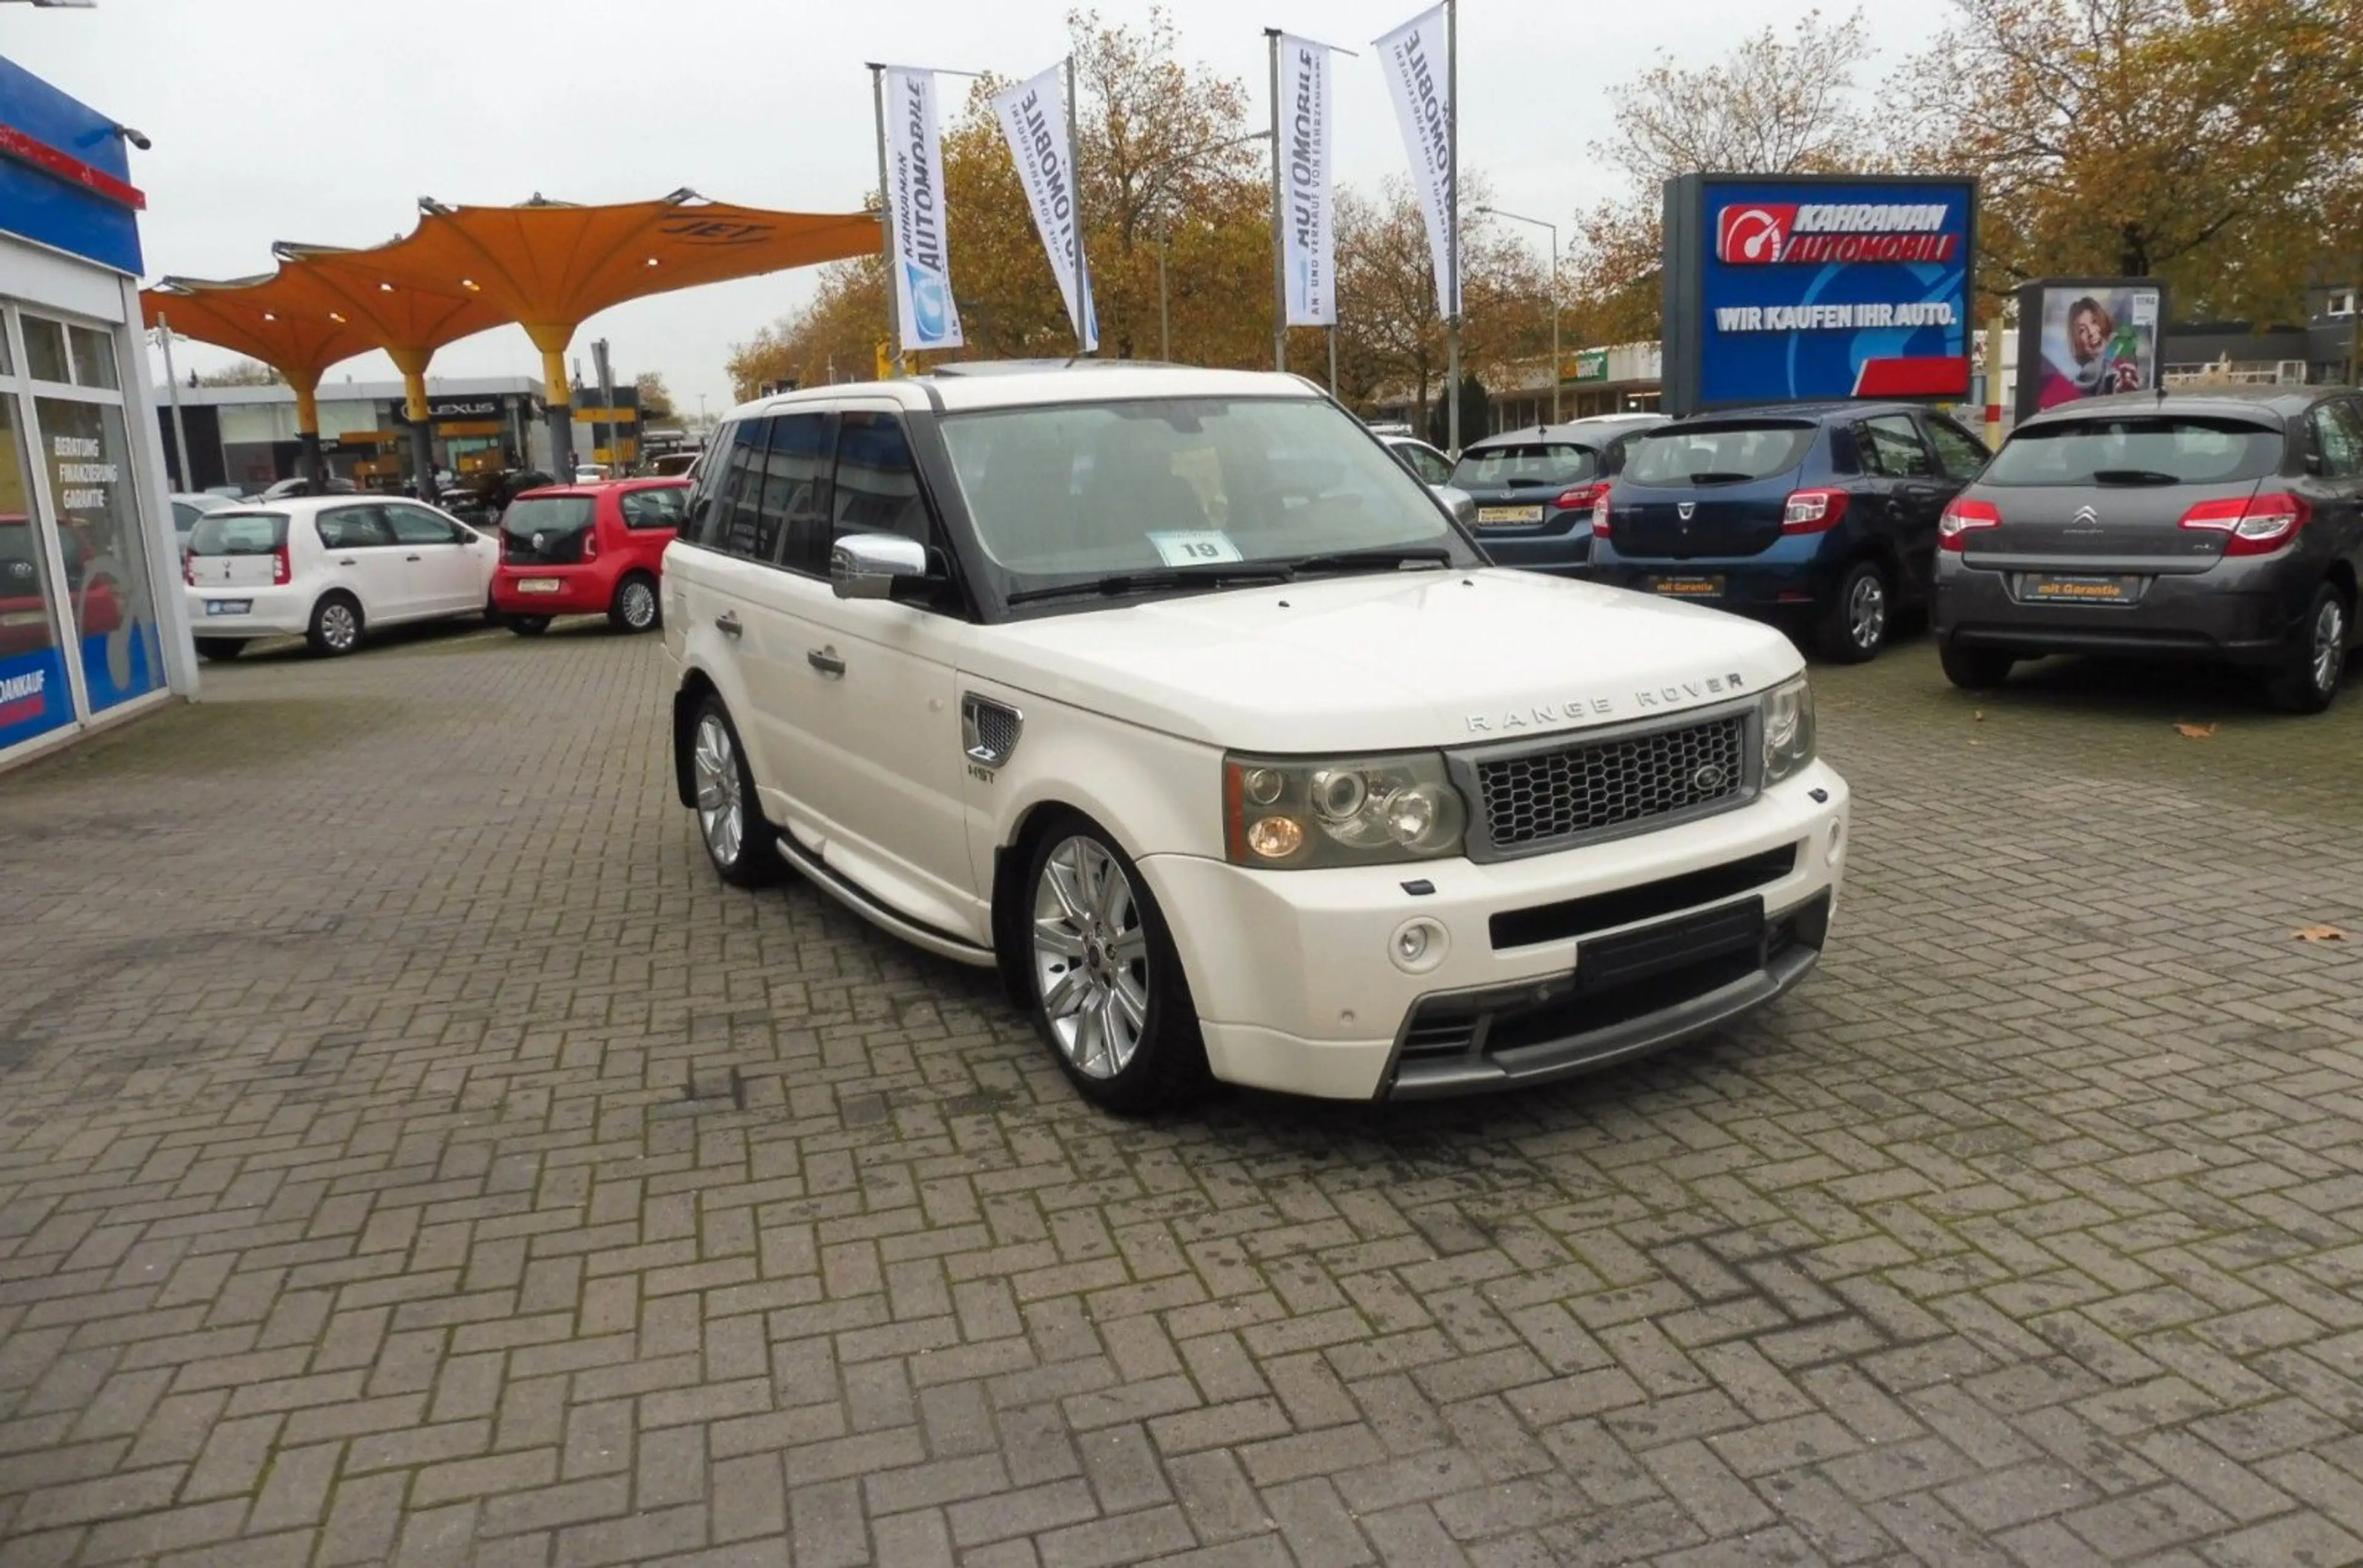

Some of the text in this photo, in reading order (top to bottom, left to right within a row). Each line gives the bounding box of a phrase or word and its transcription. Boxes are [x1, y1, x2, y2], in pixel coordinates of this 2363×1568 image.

[907, 76, 942, 273] AUTOMOBILE
[1311, 158, 1321, 188] VON
[1792, 204, 1949, 233] KAHRAMAN
[1311, 259, 1319, 287] UND
[1716, 302, 1957, 332] WIR KAUFEN IHR AUTO.
[427, 402, 495, 415] LEXUS
[54, 436, 100, 457] BERATUNG
[63, 488, 105, 510] GARANTIE
[1180, 542, 1220, 558] 19
[2037, 583, 2121, 596] mit Garantie
[1465, 672, 1745, 732] RANGE ROVER
